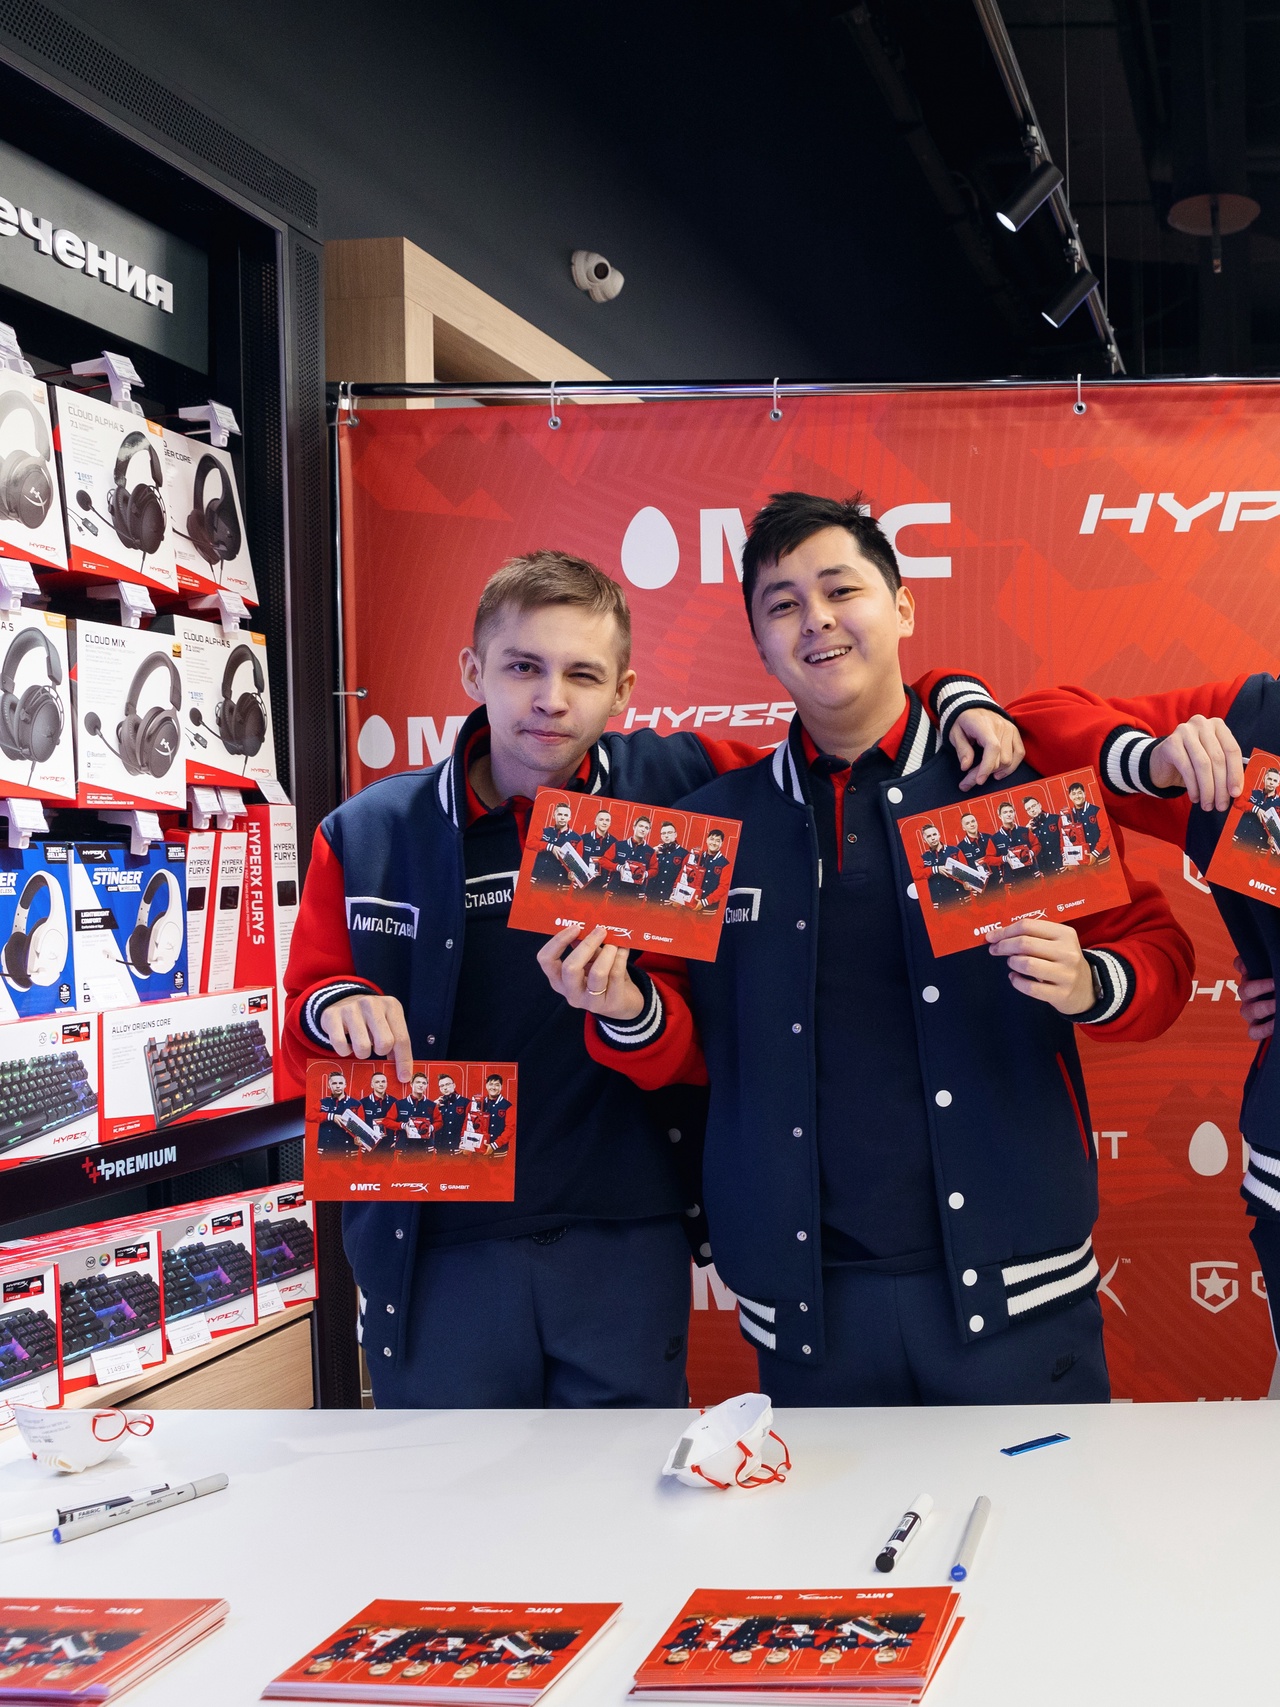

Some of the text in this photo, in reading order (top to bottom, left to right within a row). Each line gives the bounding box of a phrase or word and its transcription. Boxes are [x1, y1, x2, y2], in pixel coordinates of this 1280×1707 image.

[68, 406, 93, 421] CLOUD
[85, 633, 126, 648] CLOUD MIX
[183, 632, 204, 643] CLOUD
[204, 636, 227, 648] ALPHA
[624, 701, 798, 729] HYPER
[274, 843, 295, 851] HYPERX
[274, 852, 291, 860] FURY
[92, 871, 142, 885] STINGER
[248, 822, 265, 945] HYPERX FURY S
[112, 1017, 171, 1034] ALLOY ORIGINS CORE
[105, 1146, 177, 1181] PREMIUM
[179, 1334, 197, 1345] 11490
[106, 1364, 126, 1375] 11490
[78, 1507, 101, 1517] FABRIC
